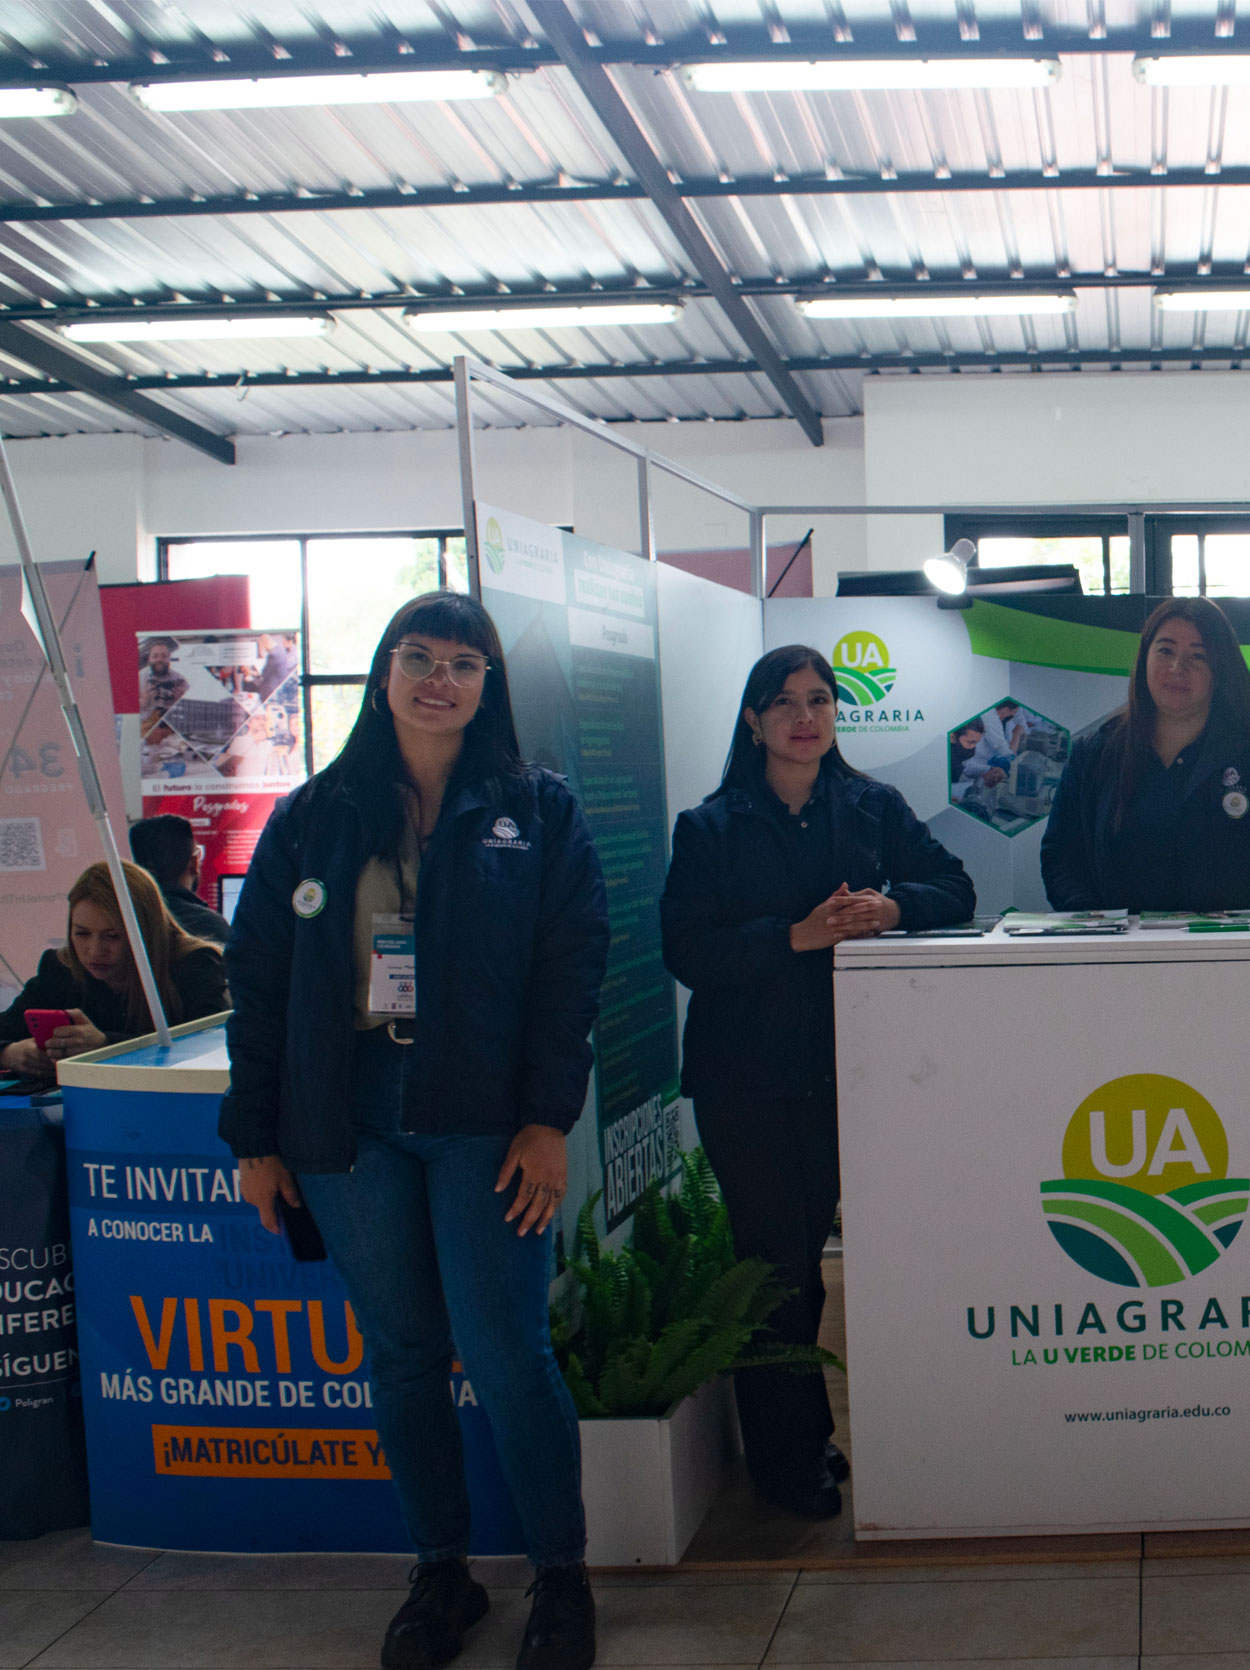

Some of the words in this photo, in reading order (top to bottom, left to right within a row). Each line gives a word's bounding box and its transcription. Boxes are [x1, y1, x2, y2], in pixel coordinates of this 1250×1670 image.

[506, 537, 559, 565] UNIAGRARIA
[841, 642, 884, 667] UA
[836, 710, 925, 722] AGRARIA
[836, 725, 857, 733] ERDE
[163, 783, 192, 792] futuro
[205, 781, 259, 791] construimos
[262, 780, 290, 790] juntos
[193, 796, 249, 816] Posgrados
[604, 1093, 663, 1165] INSCRIPCIONES
[1089, 1107, 1212, 1179] UA
[83, 1163, 118, 1199] TE
[607, 1126, 665, 1221] ABIERTAS
[88, 1218, 98, 1237] A
[101, 1219, 184, 1242] CONOCER
[188, 1223, 214, 1243] LA
[0, 1243, 68, 1271] SCUB
[1011, 1349, 1038, 1366] LA
[1043, 1347, 1058, 1365] U
[1064, 1345, 1136, 1363] VERDE
[1142, 1343, 1169, 1360] DE
[100, 1367, 153, 1403] MÁS
[160, 1377, 271, 1408] GRANDE
[279, 1381, 315, 1408] DE
[15, 1397, 54, 1409] Poligran
[1064, 1403, 1232, 1424] www.uniagraria.edu.co
[164, 1432, 357, 1468] ¡MATRICÚLATE
[364, 1440, 392, 1468] Y
